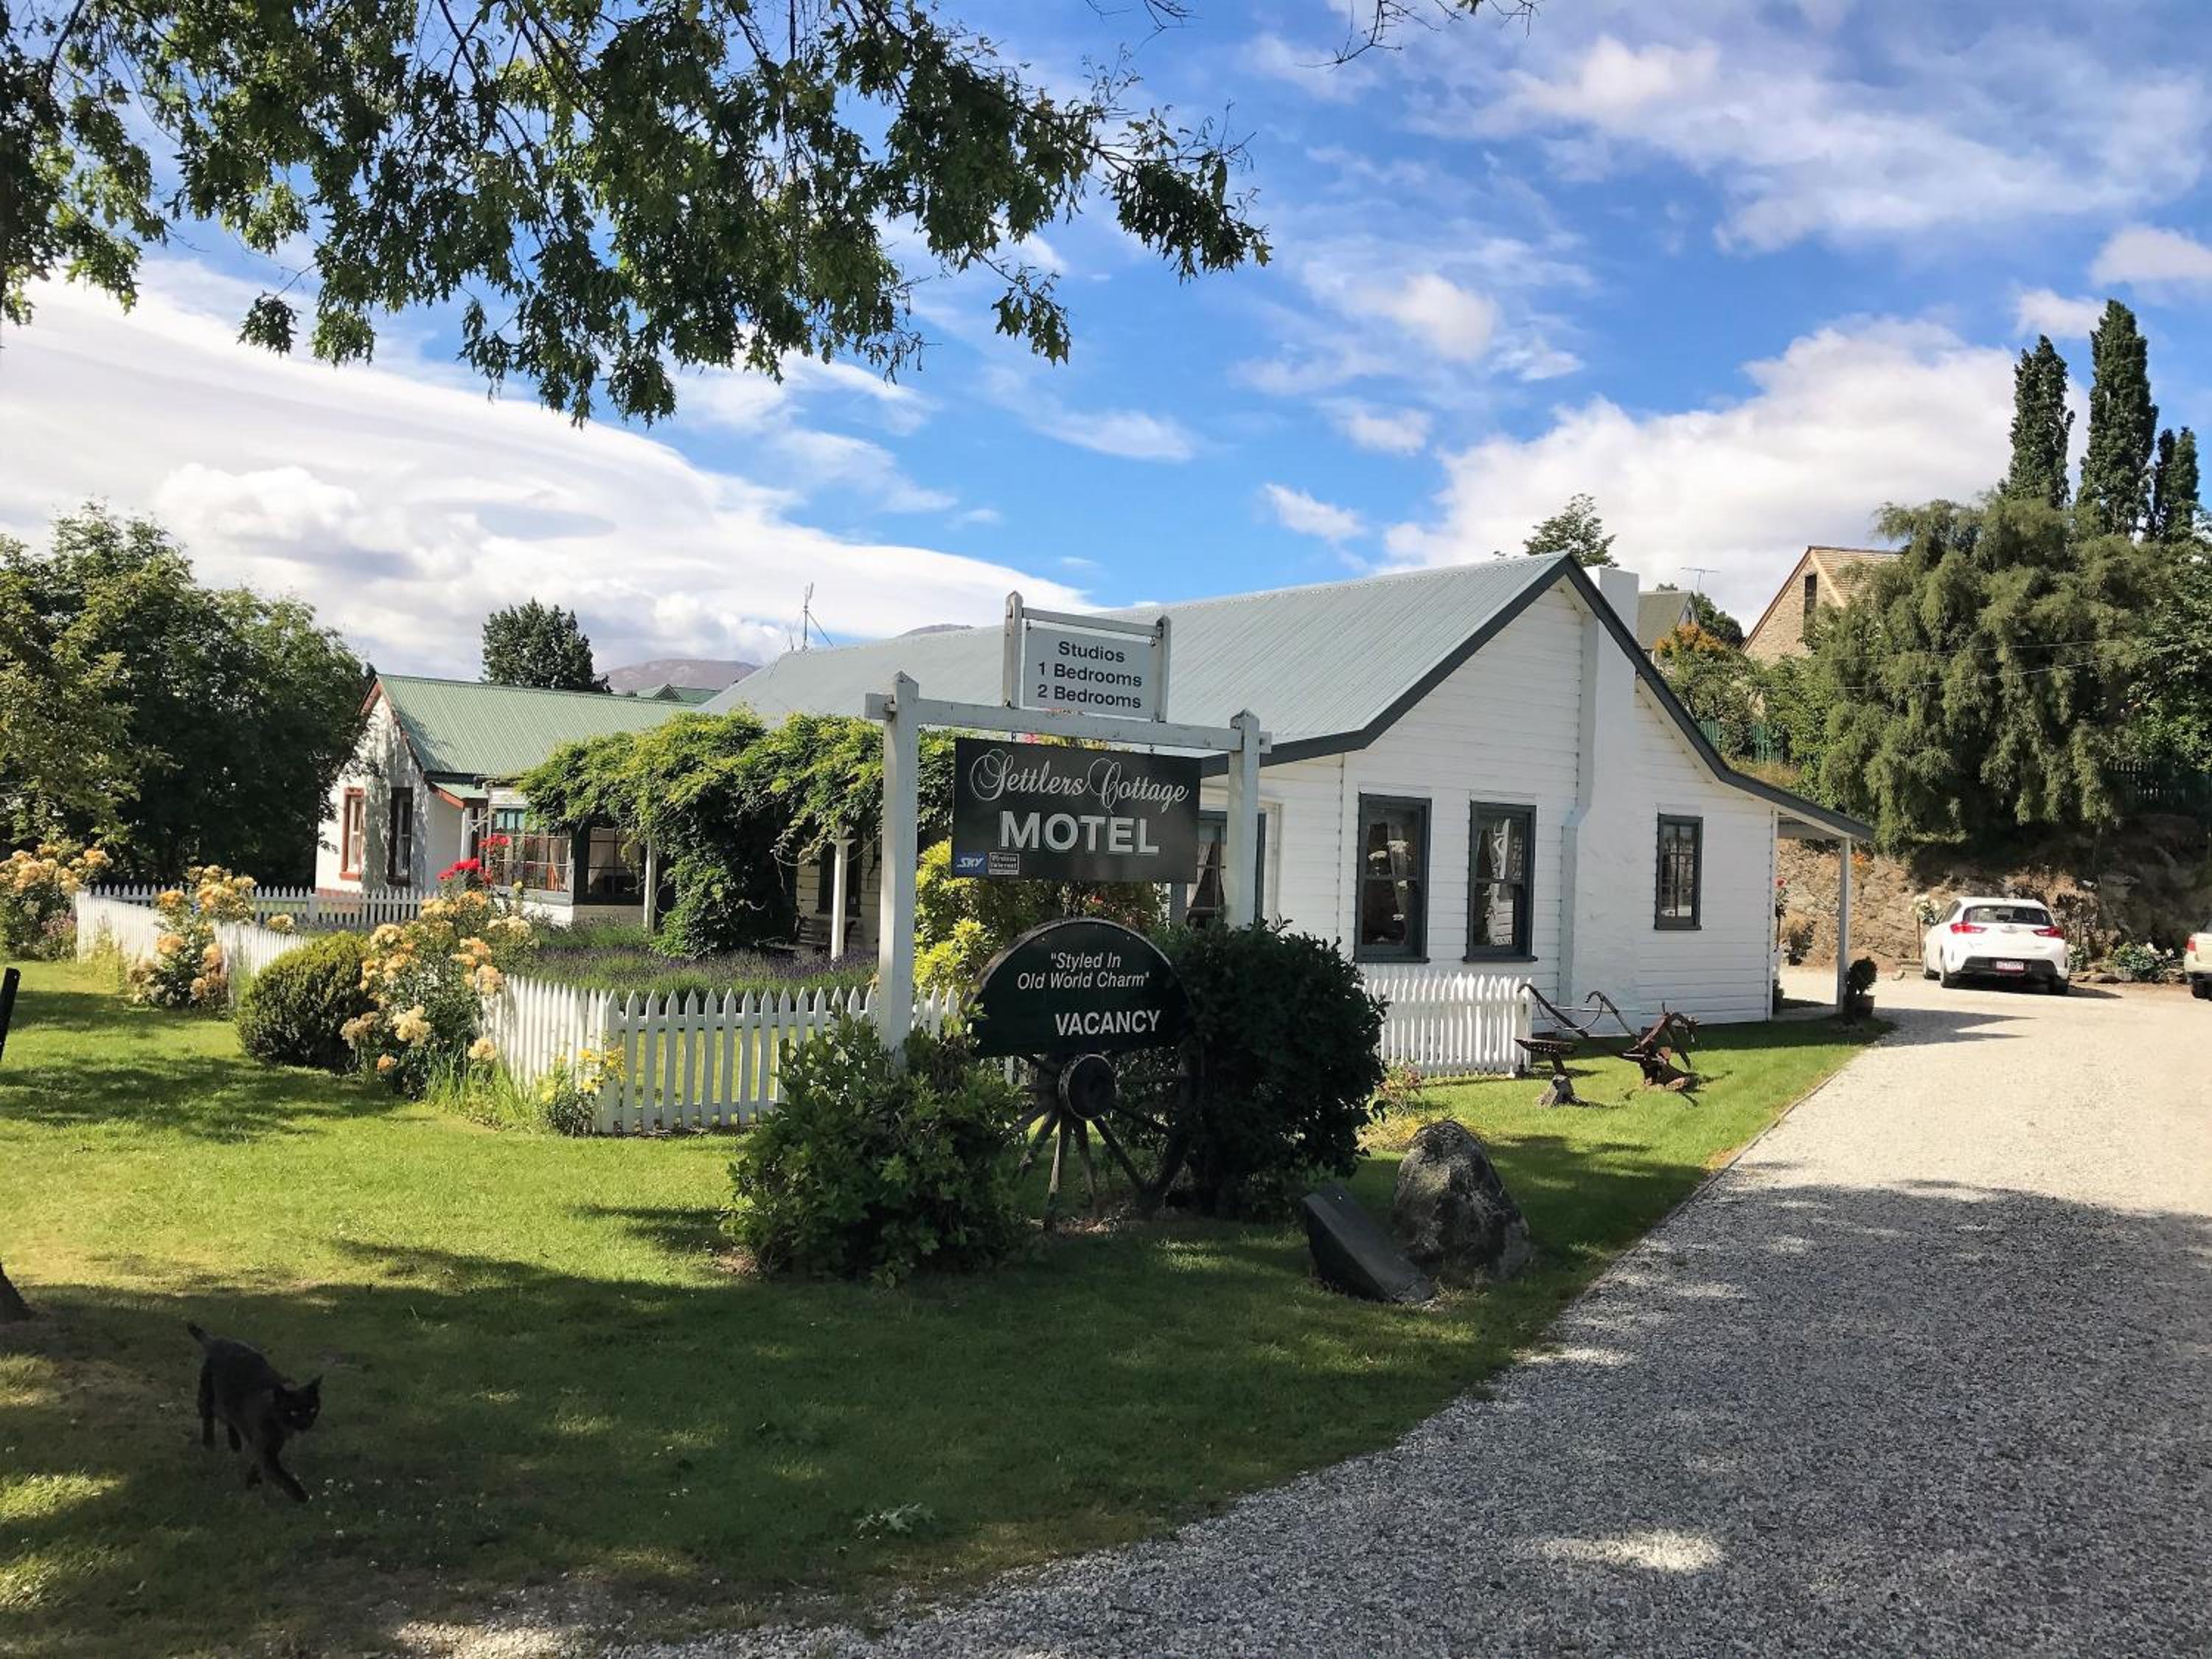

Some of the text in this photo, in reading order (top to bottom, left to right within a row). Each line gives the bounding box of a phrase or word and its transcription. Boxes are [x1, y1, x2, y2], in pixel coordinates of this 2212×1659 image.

[1058, 641, 1125, 663] Studios
[1038, 661, 1142, 687] 1 Bedrooms
[1037, 684, 1141, 709] 2 Bedrooms
[970, 748, 1189, 814] Settlers Cottage
[998, 810, 1160, 855] MOTEL
[1050, 952, 1121, 973] "Styled In
[1017, 972, 1045, 990] Old
[1050, 971, 1093, 988] World
[1055, 1009, 1161, 1036] VACANCY
